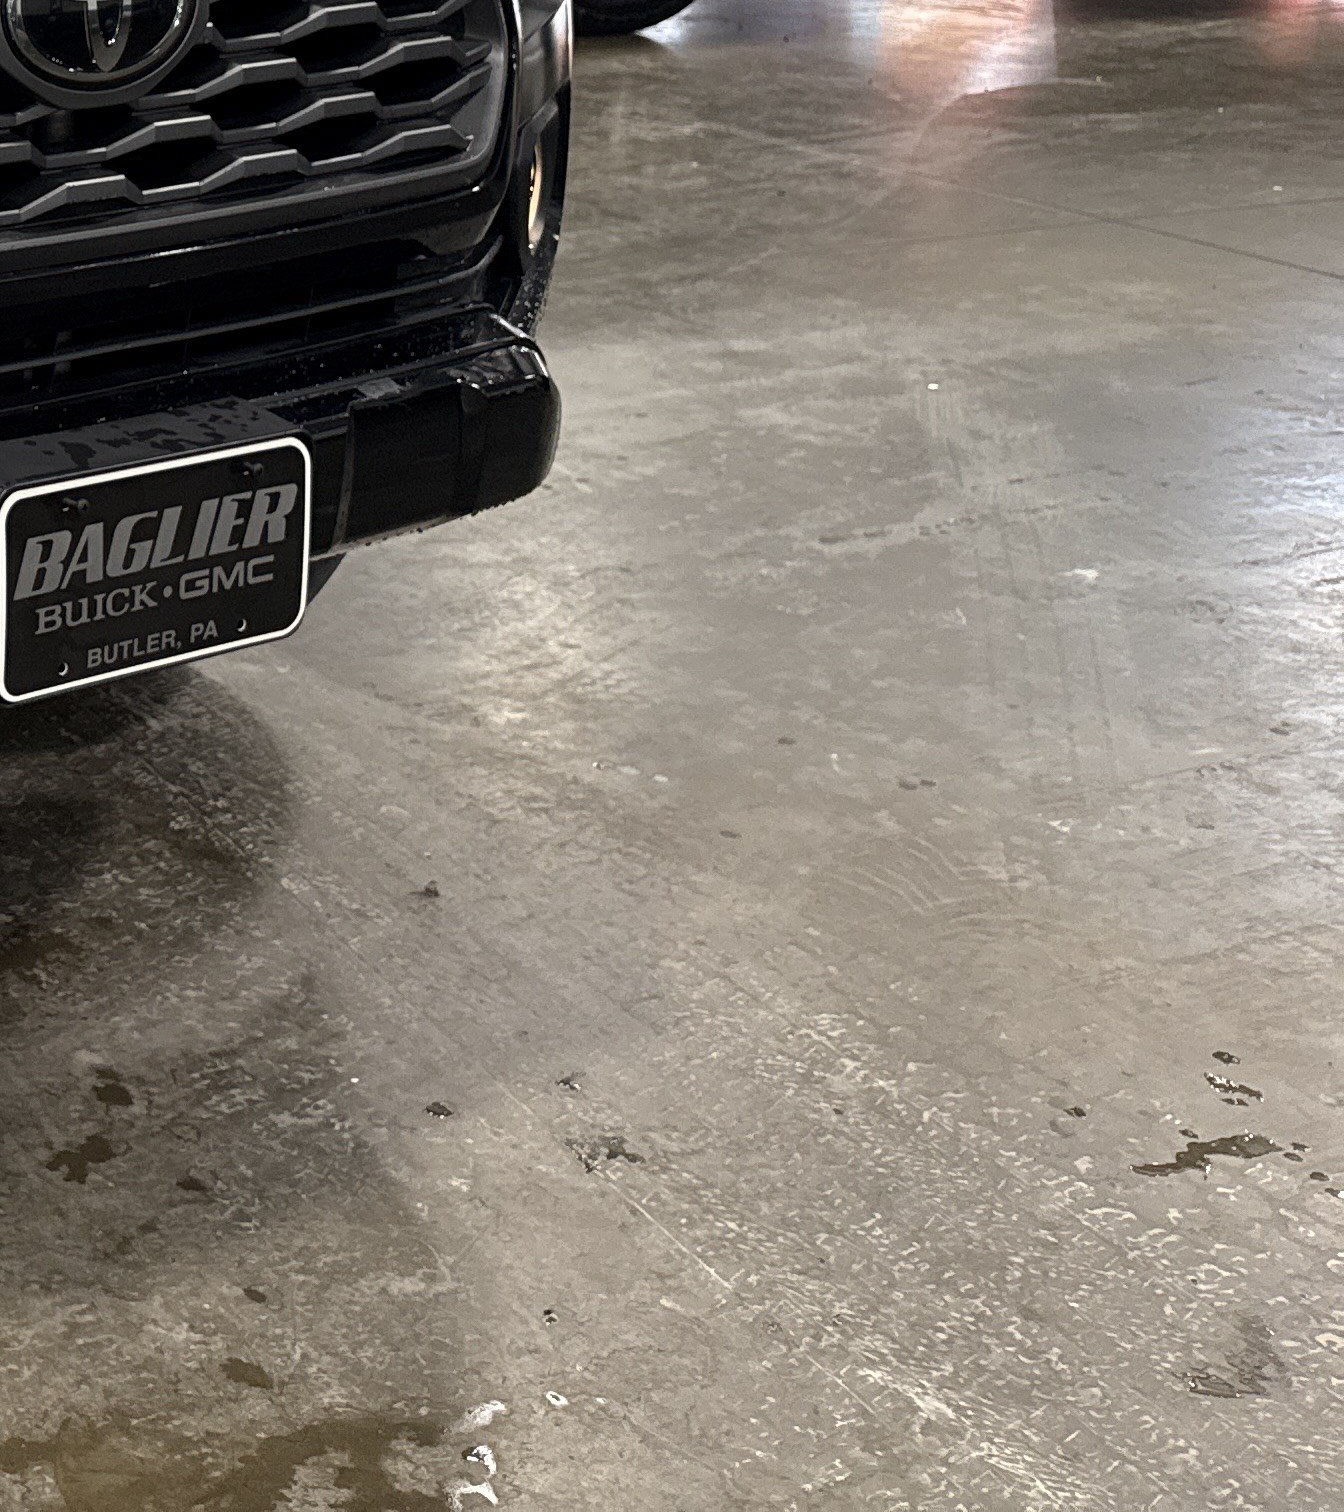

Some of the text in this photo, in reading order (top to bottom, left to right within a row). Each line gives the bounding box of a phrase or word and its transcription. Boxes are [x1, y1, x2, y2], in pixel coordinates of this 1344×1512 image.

[13, 482, 300, 602] BAGLIER
[34, 554, 275, 636] BUICK GMC
[86, 619, 219, 670] BUTLER, PA
